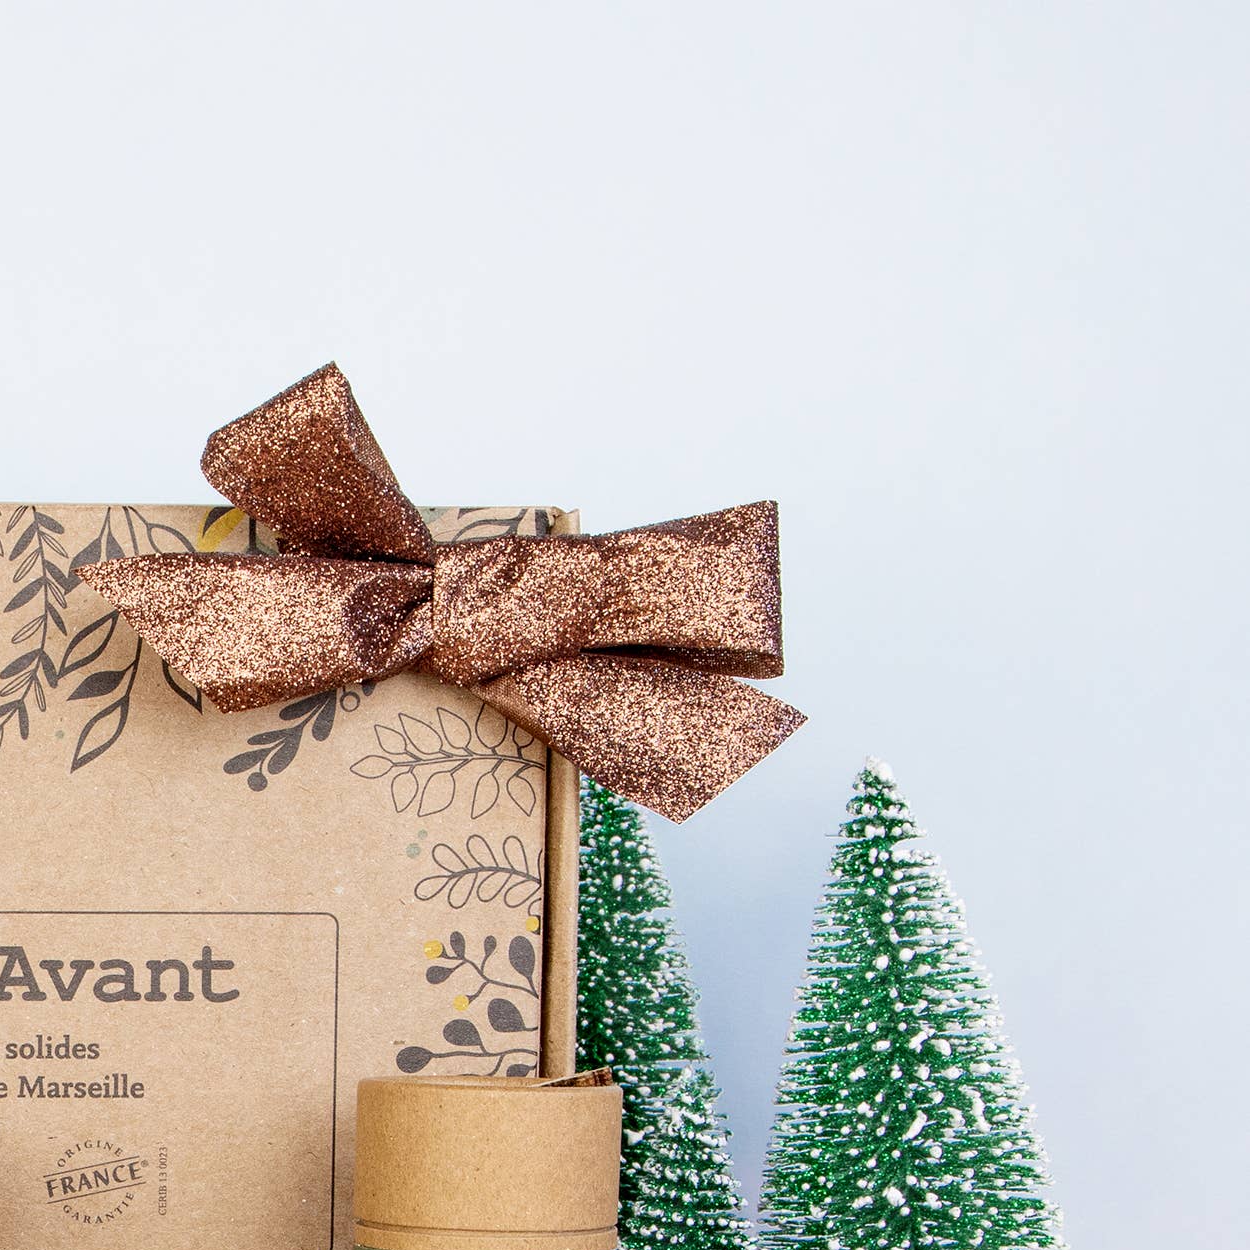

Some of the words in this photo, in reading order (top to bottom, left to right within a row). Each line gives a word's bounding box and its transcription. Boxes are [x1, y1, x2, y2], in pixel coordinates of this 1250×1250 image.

[5, 1034, 100, 1060] solides
[17, 1073, 145, 1099] Marseille
[57, 1139, 123, 1168] ORIGINE
[158, 1146, 168, 1170] 0023
[46, 1161, 143, 1199] FRANCE
[62, 1191, 135, 1225] GARANTIE
[158, 1185, 168, 1216] CERIB
